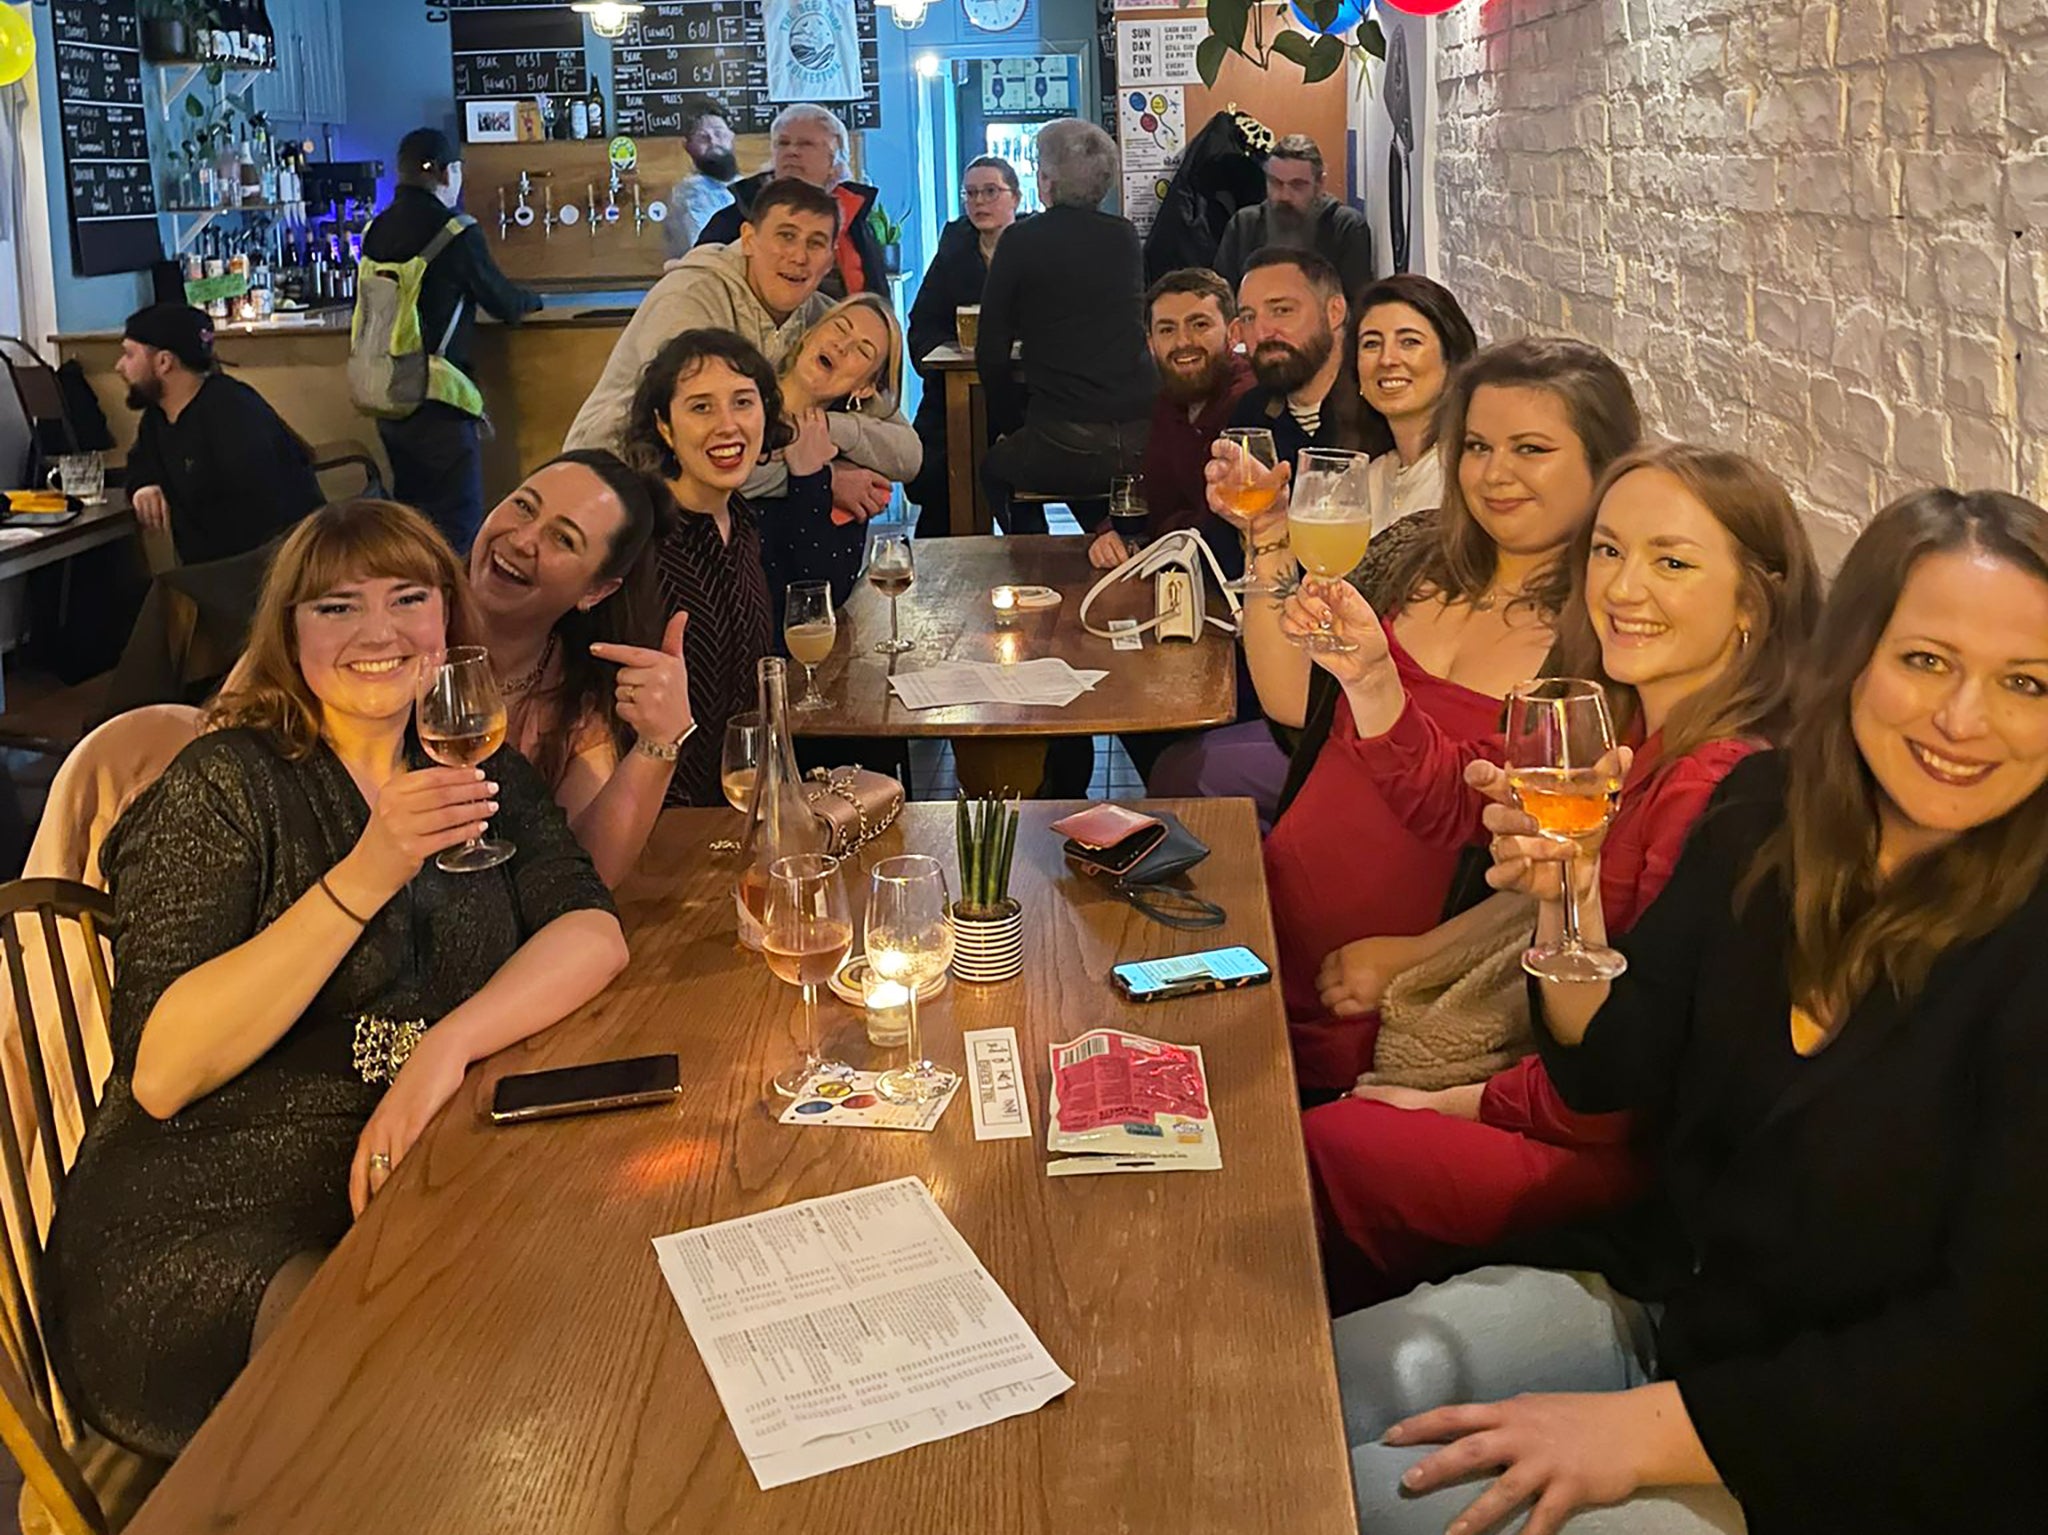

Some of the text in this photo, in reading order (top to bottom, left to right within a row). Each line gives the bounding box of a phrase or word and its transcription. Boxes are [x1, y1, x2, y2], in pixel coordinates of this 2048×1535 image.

[779, 10, 798, 31] THE
[1131, 29, 1151, 39] SUN
[1132, 41, 1152, 52] DAY
[1132, 54, 1152, 65] FUN
[1165, 62, 1185, 70] EVERY
[1133, 67, 1153, 78] DAY
